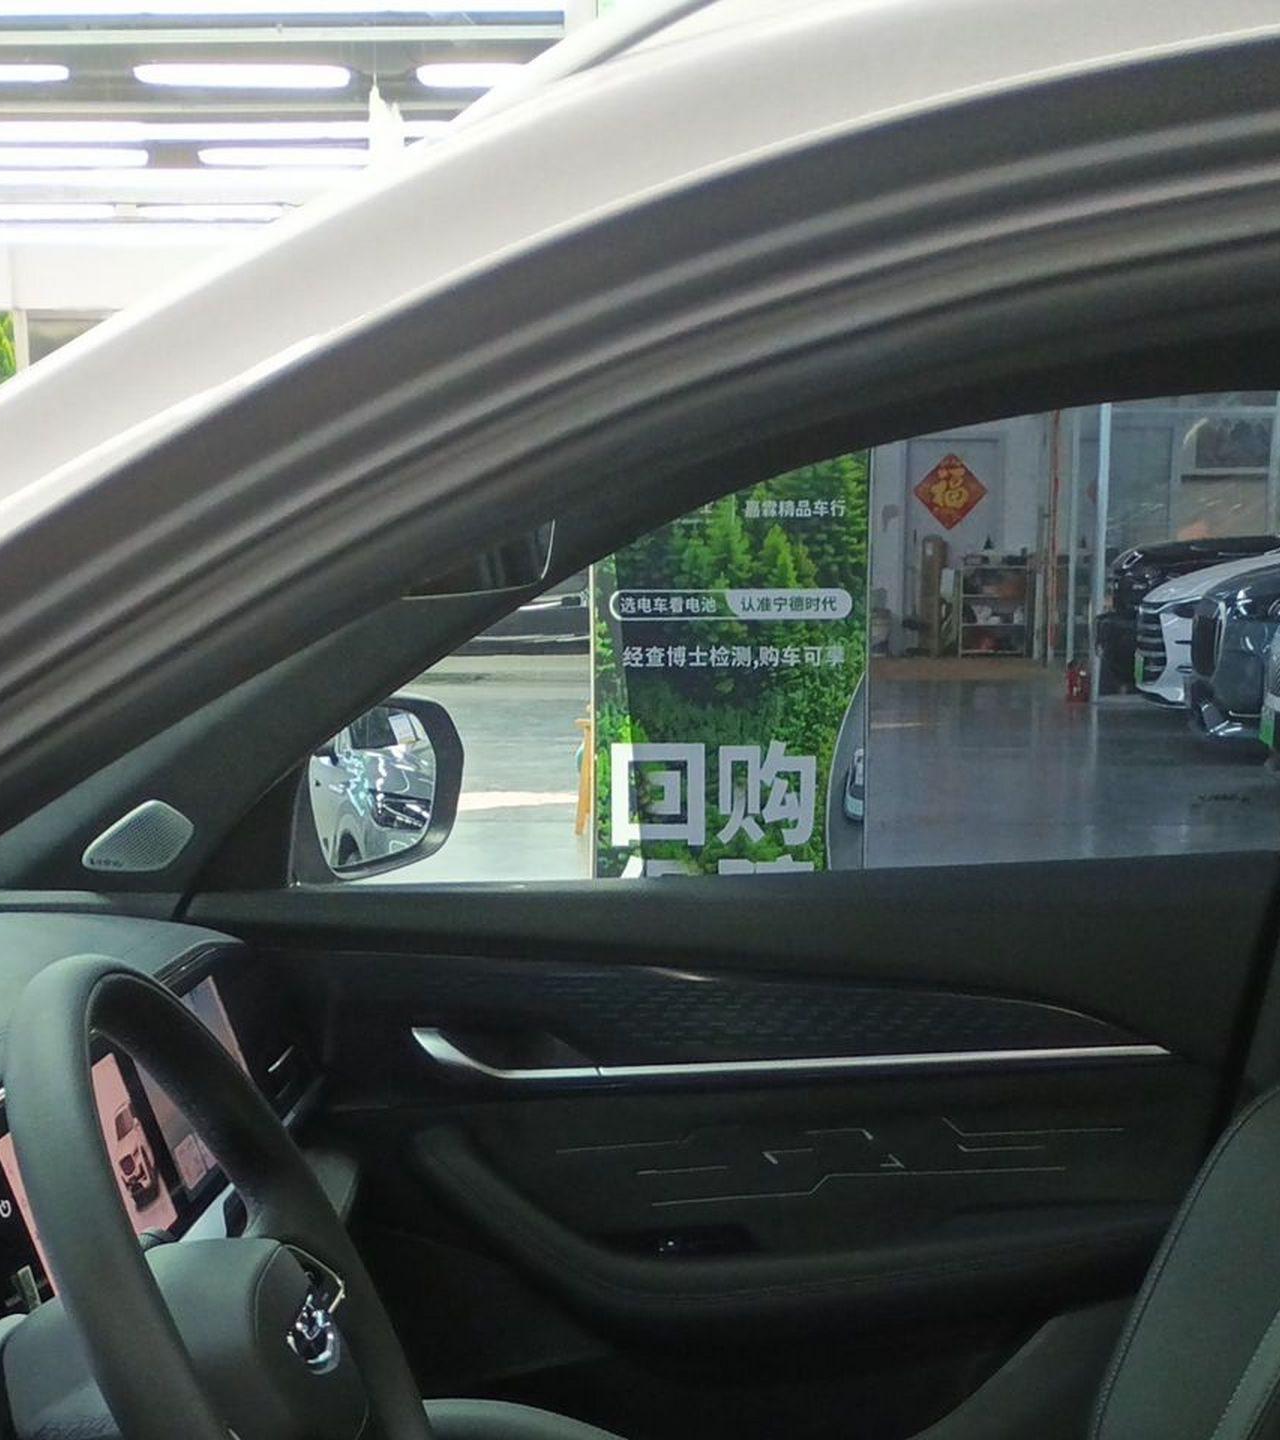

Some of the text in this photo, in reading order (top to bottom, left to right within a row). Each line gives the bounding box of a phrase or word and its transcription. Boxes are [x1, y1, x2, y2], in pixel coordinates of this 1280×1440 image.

[620, 596, 838, 614] 选电车看电池 认准宁德时代
[610, 738, 817, 848] 回购
